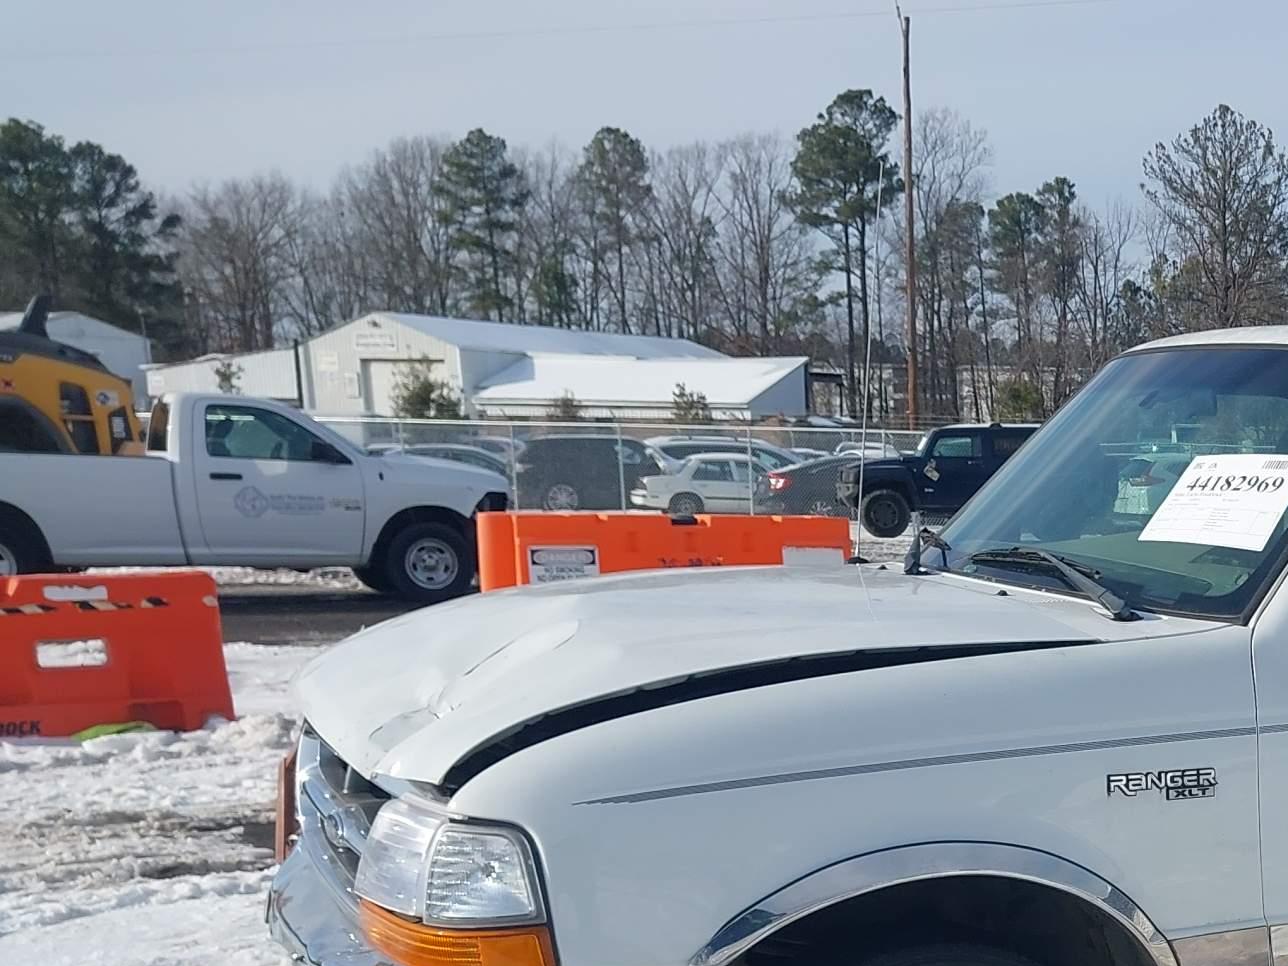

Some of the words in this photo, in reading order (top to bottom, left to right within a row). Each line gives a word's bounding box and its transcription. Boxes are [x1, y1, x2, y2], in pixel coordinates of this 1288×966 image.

[1186, 475, 1285, 492] 44182969
[1106, 767, 1218, 796] RANGER
[1171, 787, 1212, 799] XLT
